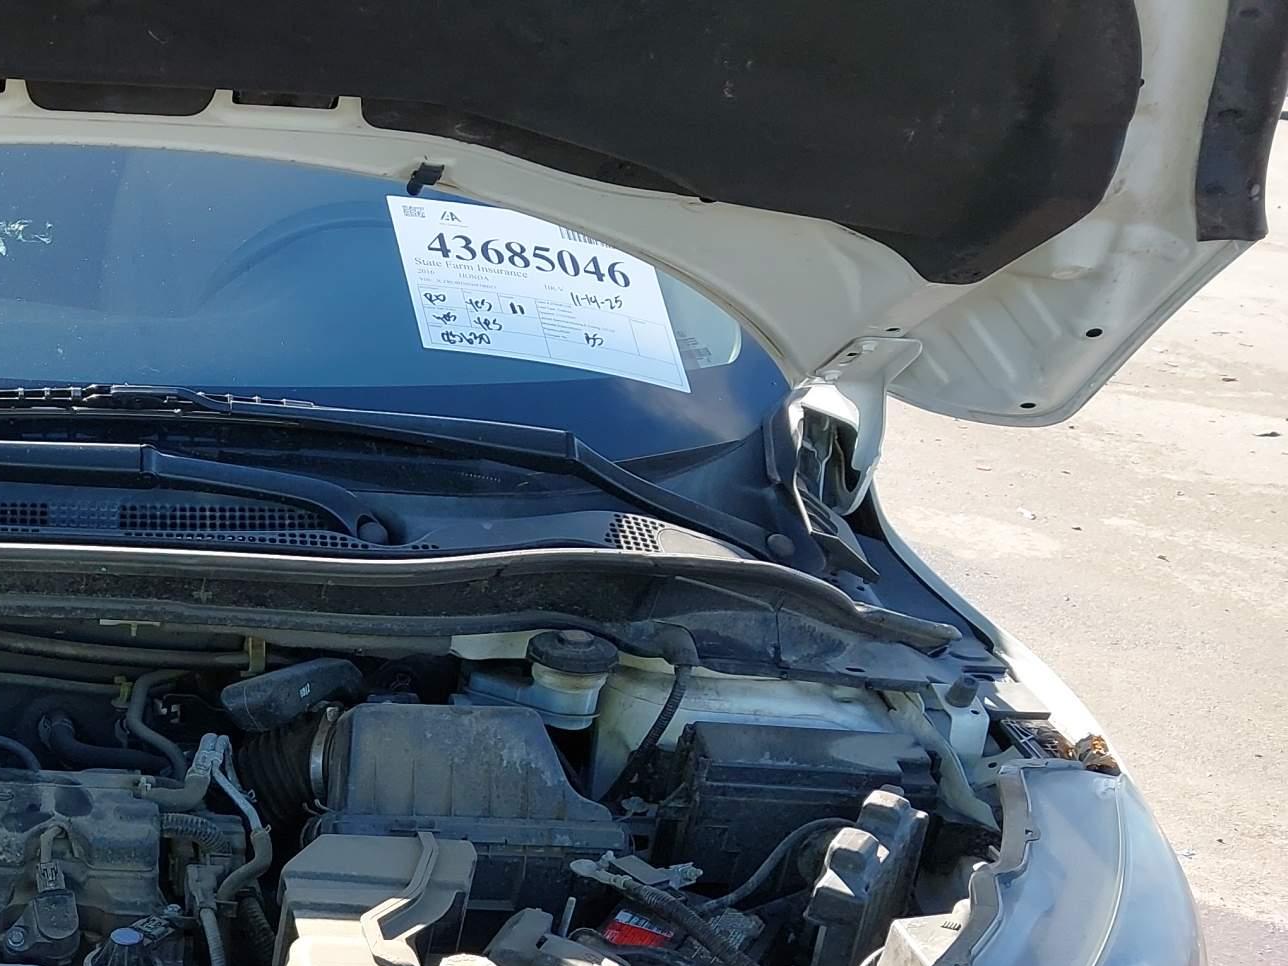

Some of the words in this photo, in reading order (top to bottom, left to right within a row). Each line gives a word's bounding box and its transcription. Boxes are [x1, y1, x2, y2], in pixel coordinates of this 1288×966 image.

[414, 257, 442, 268] State
[446, 260, 474, 272] Farm
[477, 263, 528, 279] Insurance
[427, 232, 630, 288] 43685046
[570, 292, 623, 310] 11-14-25
